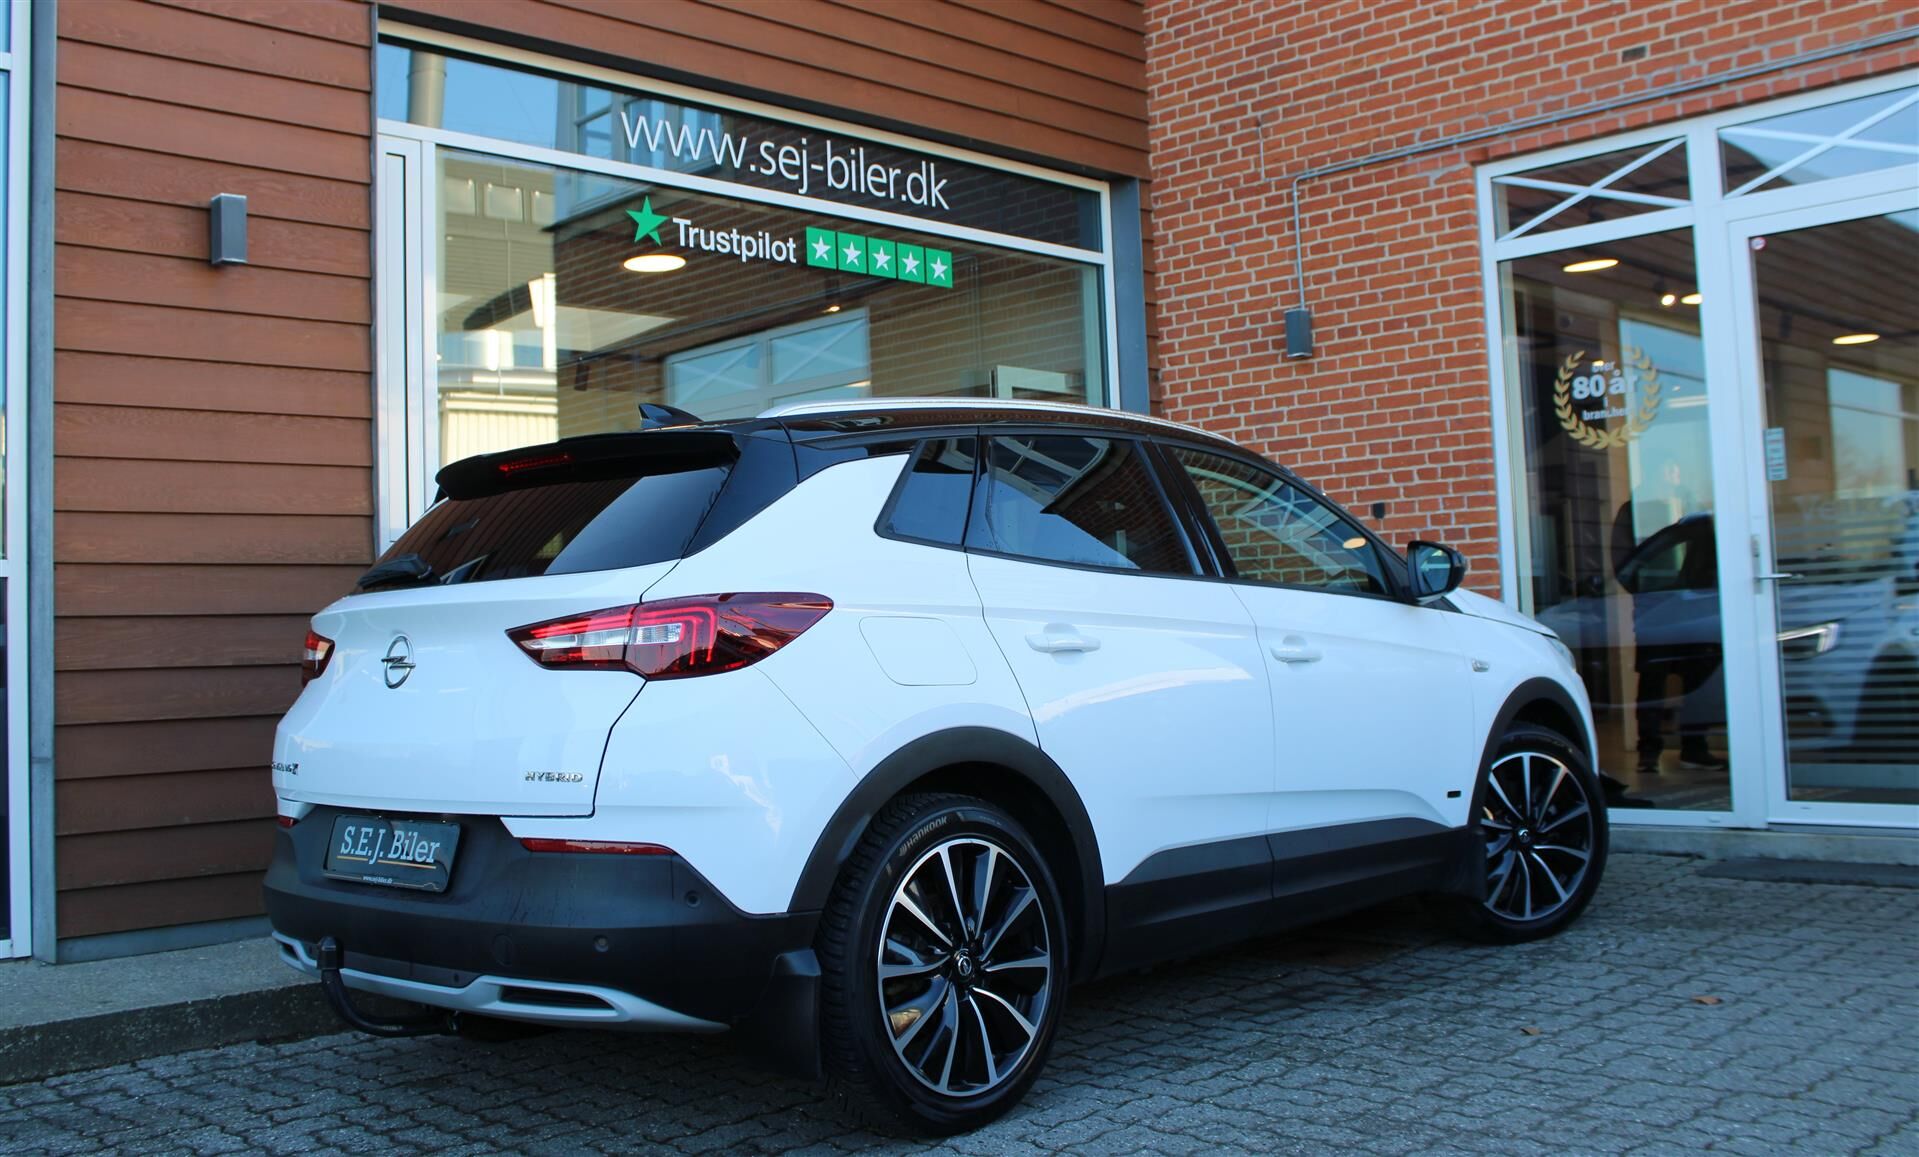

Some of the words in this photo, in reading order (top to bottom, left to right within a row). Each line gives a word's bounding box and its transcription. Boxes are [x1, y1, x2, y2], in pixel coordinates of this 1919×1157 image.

[621, 111, 950, 210] www.sej-biler.dk
[672, 217, 797, 263] Trustpilot
[1572, 374, 1606, 399] 80
[525, 771, 583, 783] HYBRID
[340, 826, 385, 865] S.E.J.
[387, 829, 441, 863] Biler
